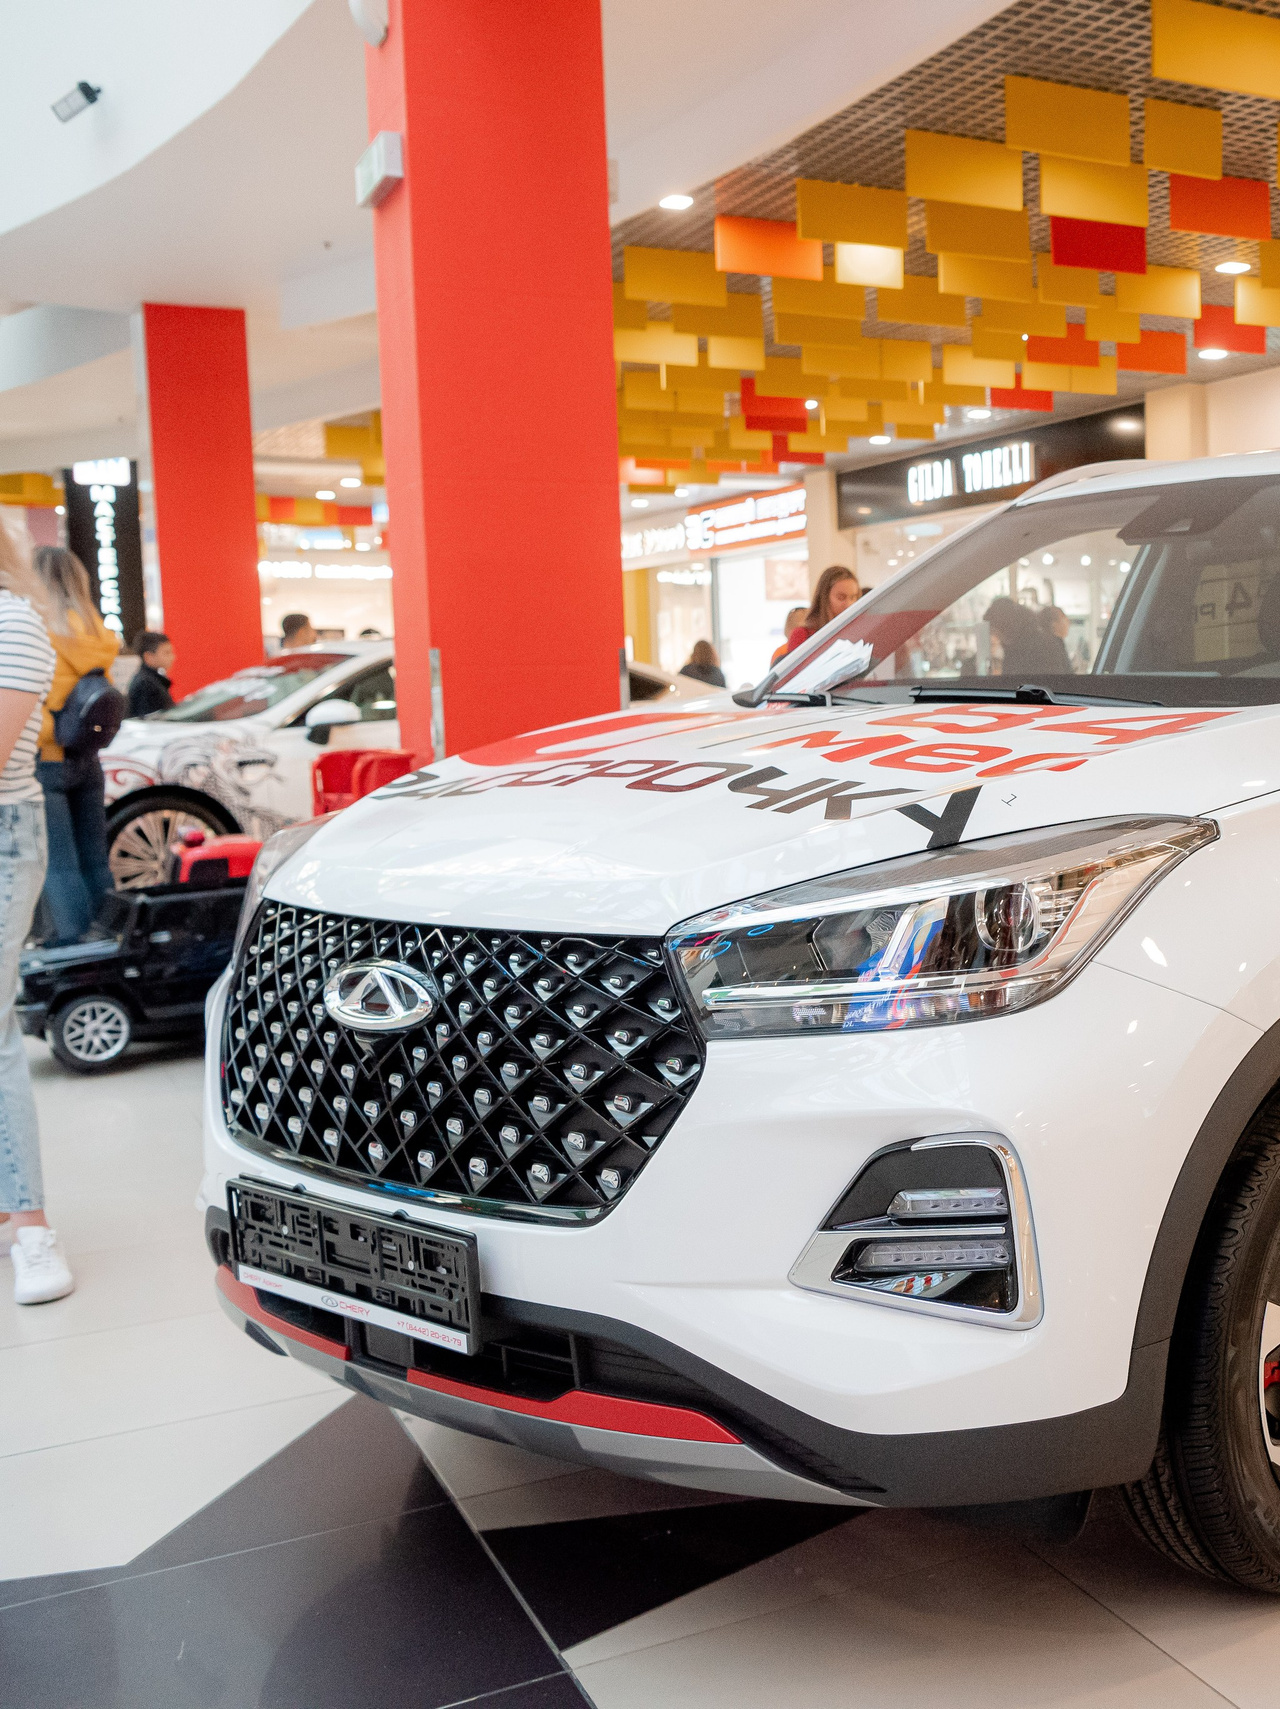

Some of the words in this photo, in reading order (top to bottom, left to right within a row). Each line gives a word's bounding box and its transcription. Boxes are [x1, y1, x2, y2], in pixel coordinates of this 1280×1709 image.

[908, 458, 953, 503] GILDA
[962, 441, 1031, 493] TONELLI
[339, 1300, 370, 1316] CHERY
